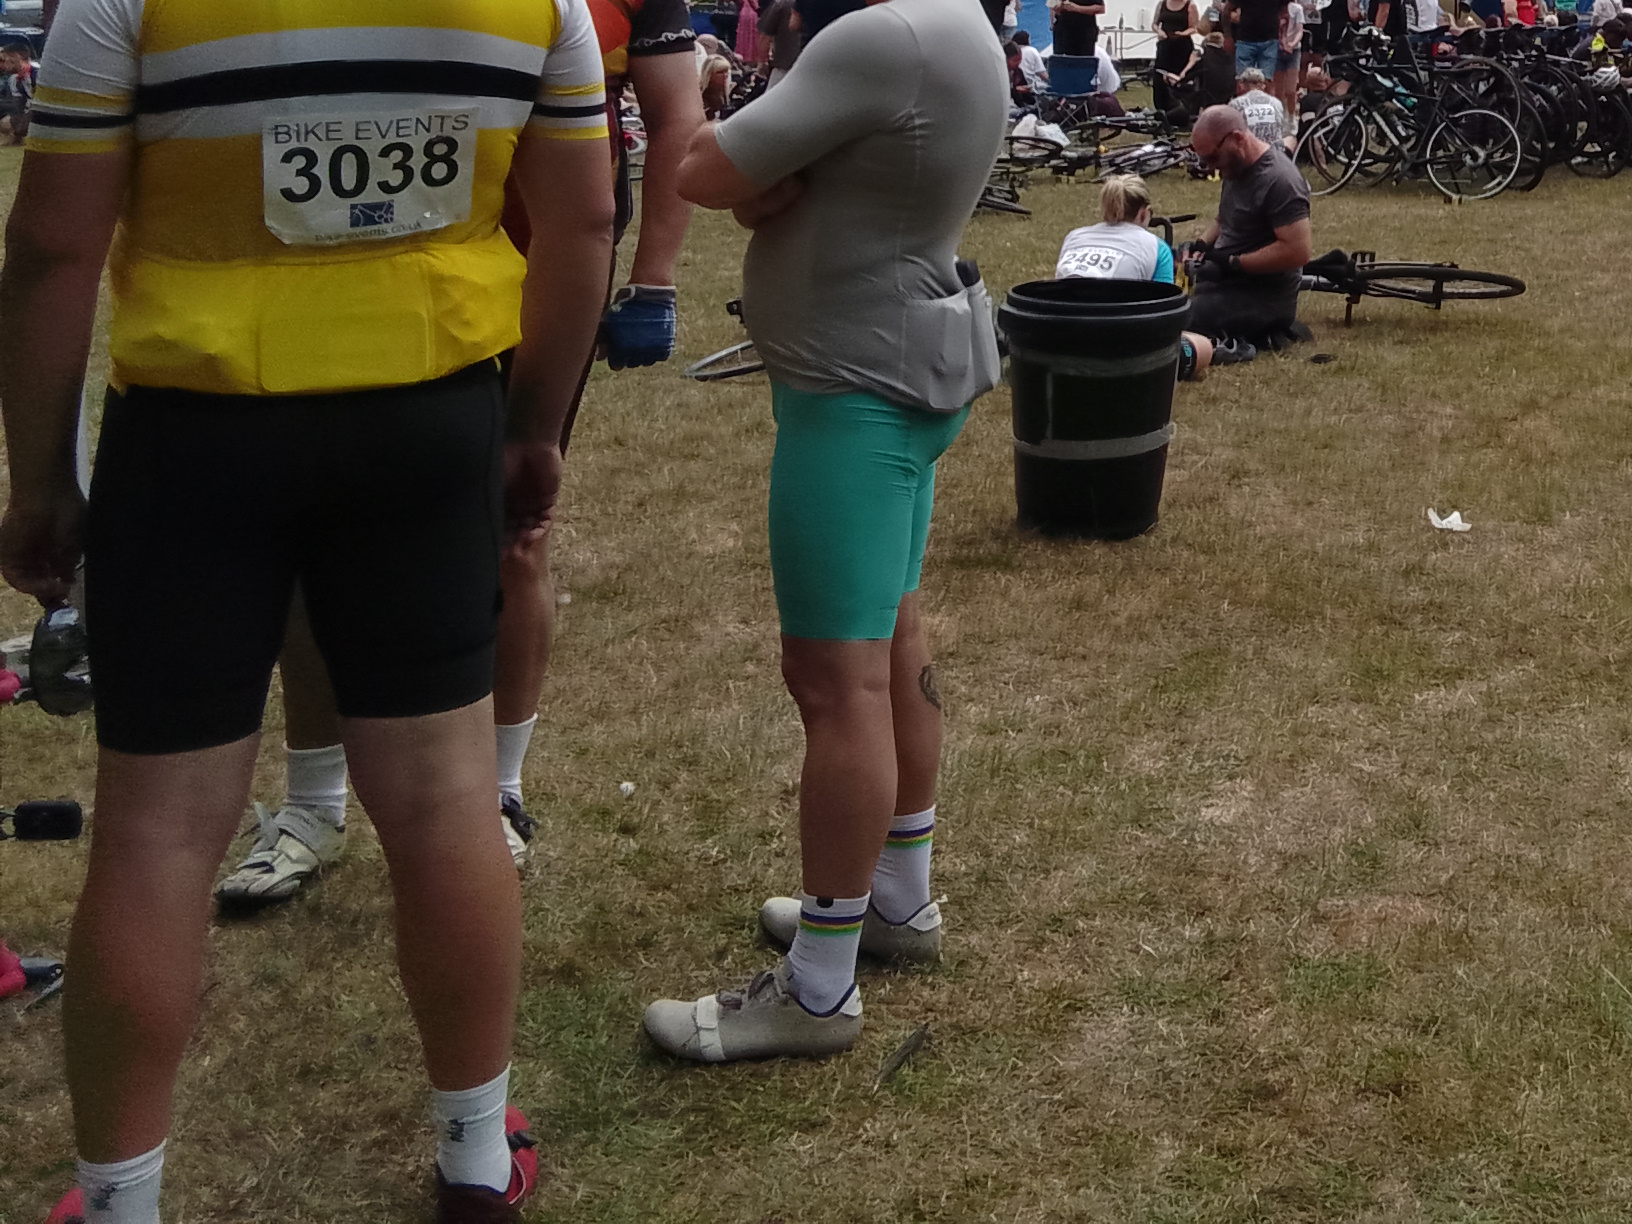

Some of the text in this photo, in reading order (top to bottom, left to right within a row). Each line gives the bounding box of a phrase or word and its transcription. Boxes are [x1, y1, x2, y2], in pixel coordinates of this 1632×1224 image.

[274, 114, 470, 144] BIKE EVENTS
[279, 134, 459, 203] 3038
[1061, 252, 1117, 272] 2495
